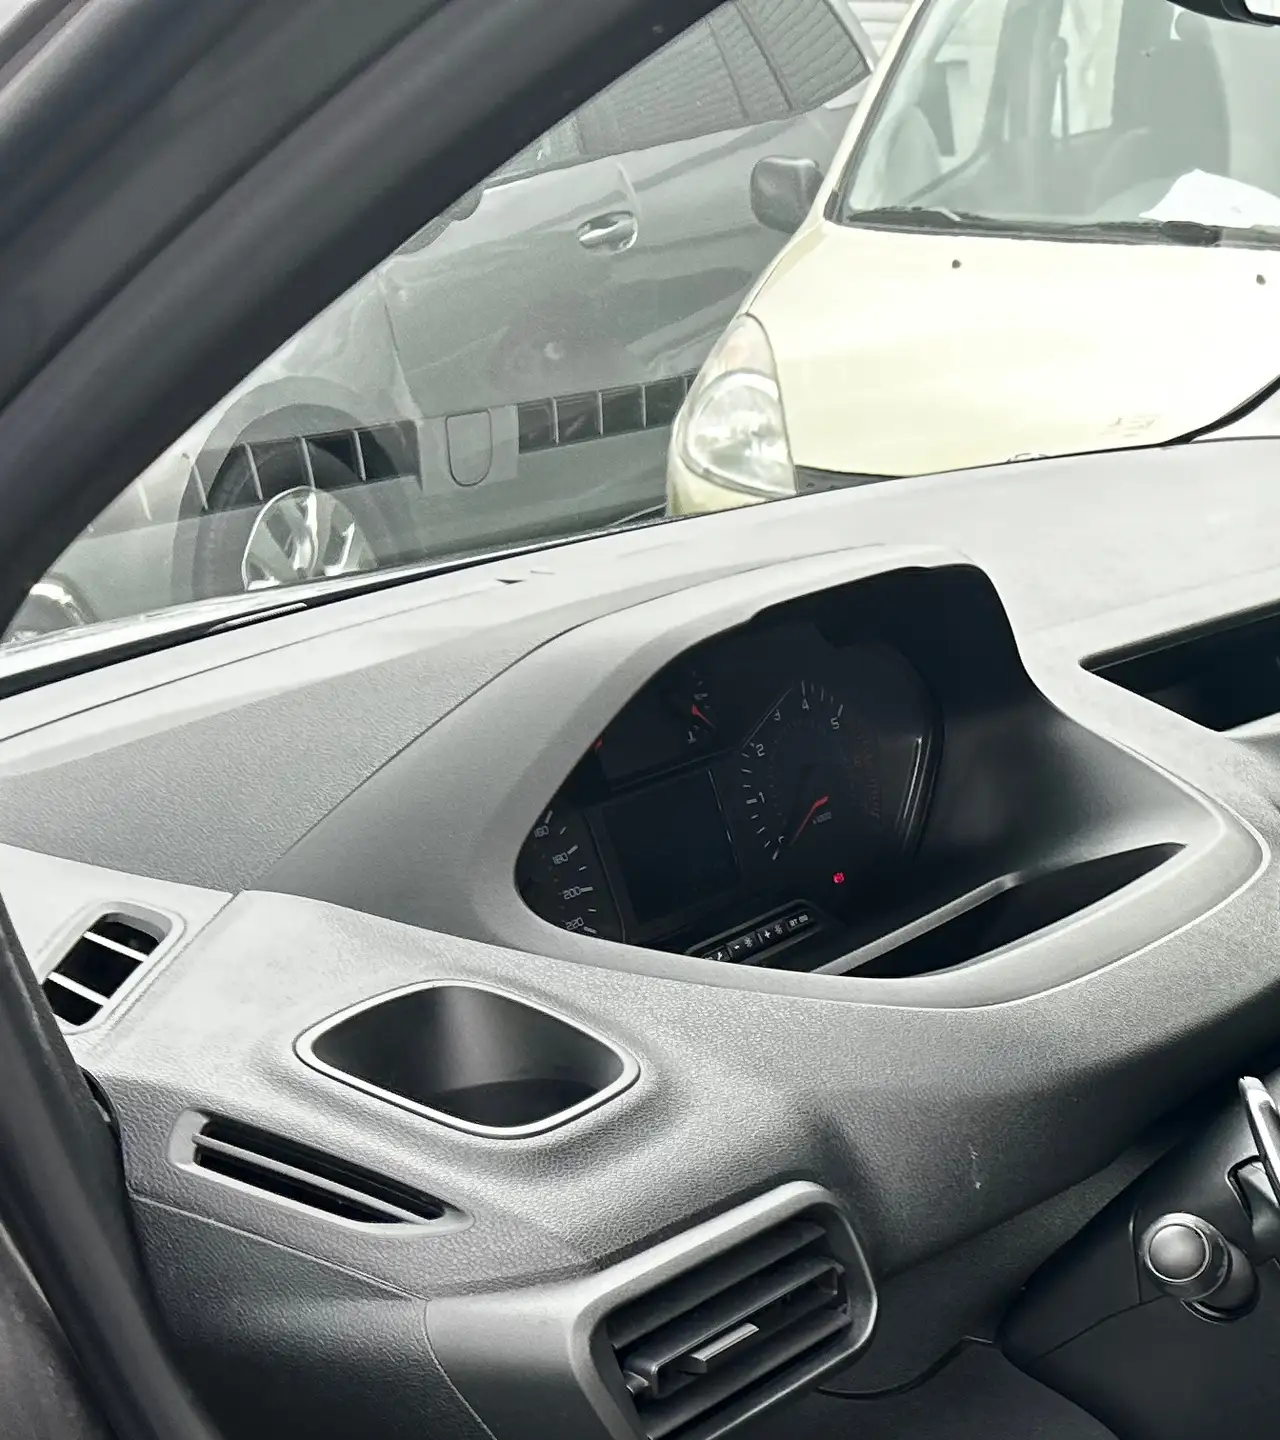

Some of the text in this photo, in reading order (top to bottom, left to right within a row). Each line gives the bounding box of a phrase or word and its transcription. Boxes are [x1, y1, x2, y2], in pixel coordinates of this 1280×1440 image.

[801, 698, 810, 711] 4
[830, 717, 840, 730] 5
[755, 743, 766, 757] 2
[563, 885, 582, 900] 200
[565, 917, 584, 931] 220
